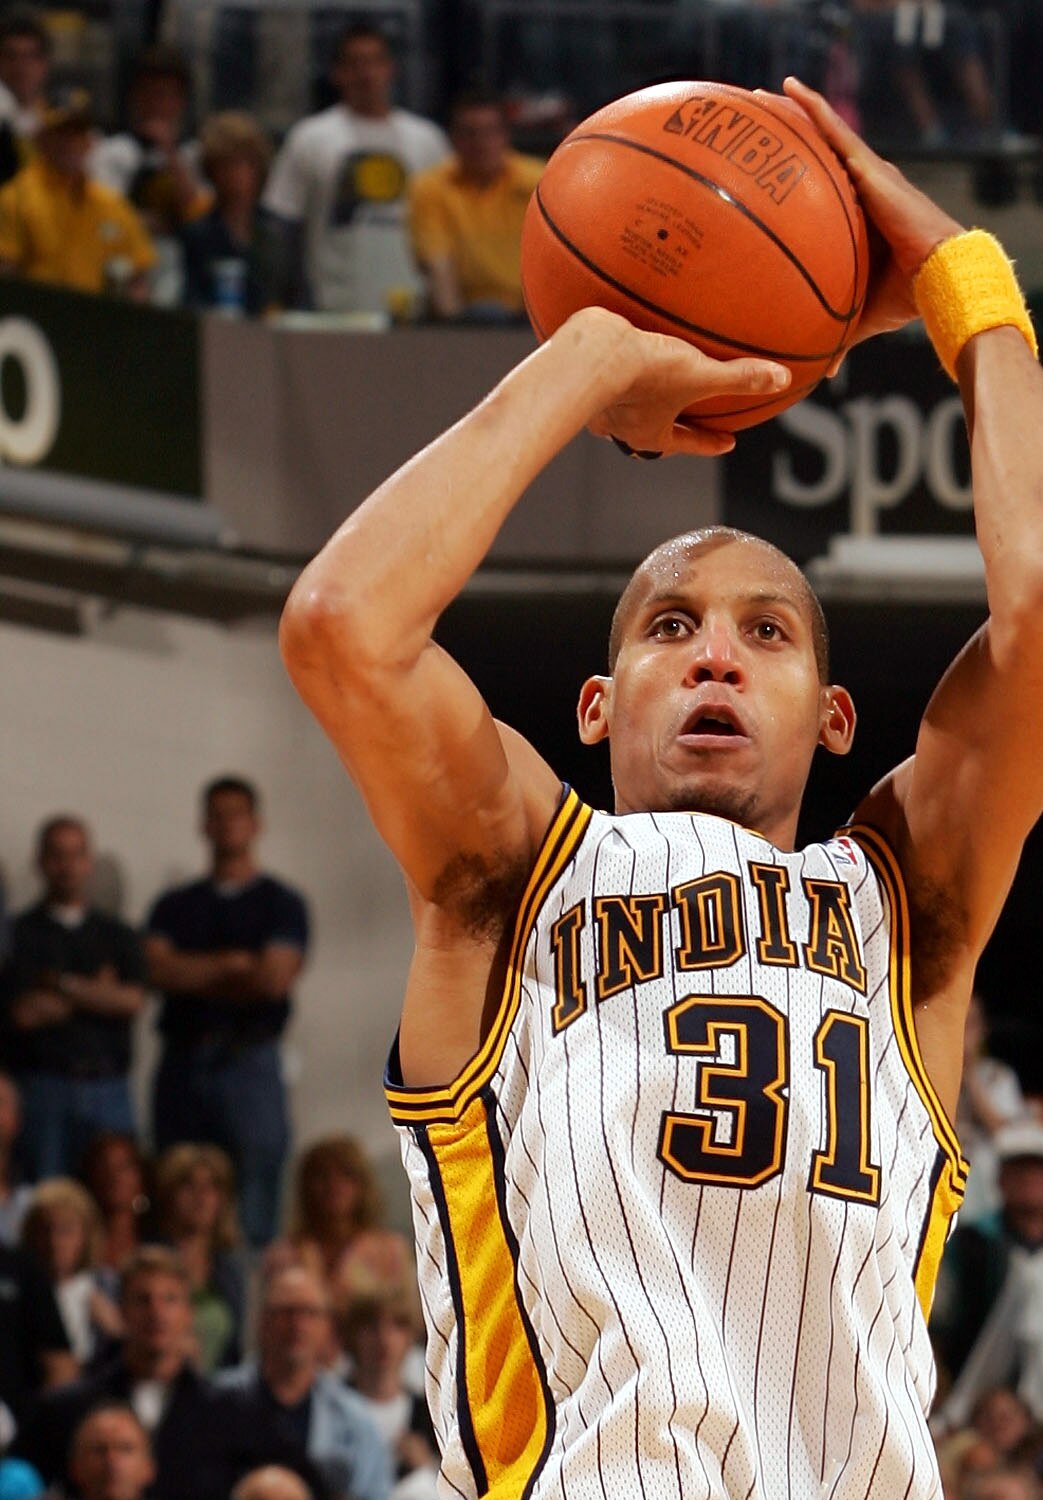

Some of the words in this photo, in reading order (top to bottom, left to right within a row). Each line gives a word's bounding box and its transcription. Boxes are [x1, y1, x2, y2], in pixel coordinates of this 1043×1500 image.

[692, 106, 808, 205] NBA
[551, 860, 868, 1037] INDIA
[656, 993, 882, 1207] 31
